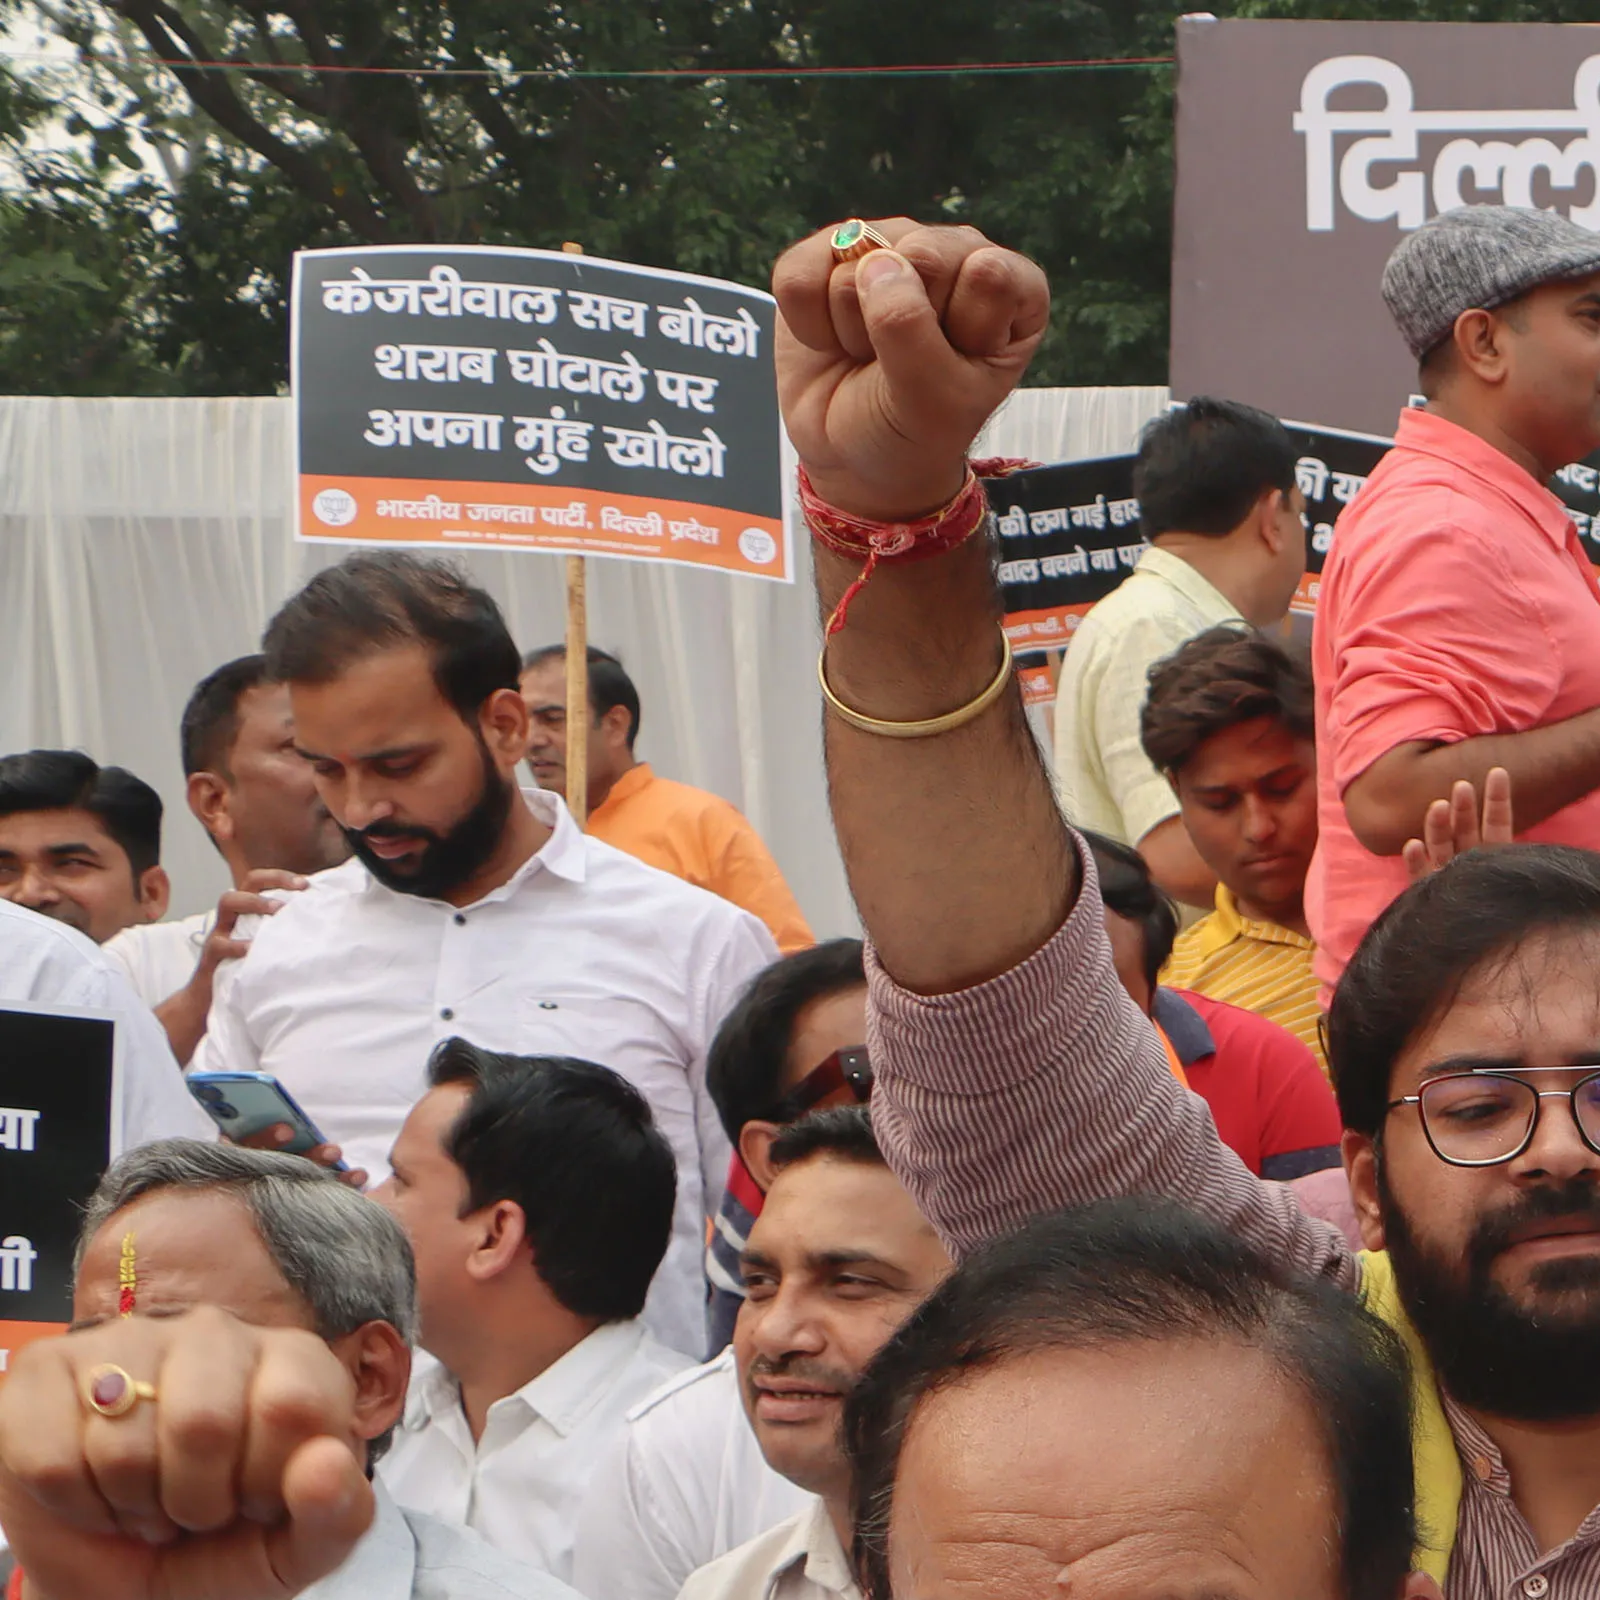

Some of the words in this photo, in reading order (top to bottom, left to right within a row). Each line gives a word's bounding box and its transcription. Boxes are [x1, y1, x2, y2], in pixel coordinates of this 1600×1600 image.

[322, 265, 562, 323] केजरीवाल
[568, 289, 648, 338] सच
[657, 297, 760, 358] बोलो
[374, 343, 499, 384] शराब
[506, 337, 649, 402] घोटाले
[654, 368, 719, 414] पर
[363, 409, 504, 451] अपना
[513, 406, 594, 475] मुंह
[602, 419, 727, 478] खोलो
[376, 495, 461, 521] भारतीय
[465, 504, 535, 523] जनता
[600, 506, 664, 538] दिल्ली
[668, 518, 721, 546] प्रदेश
